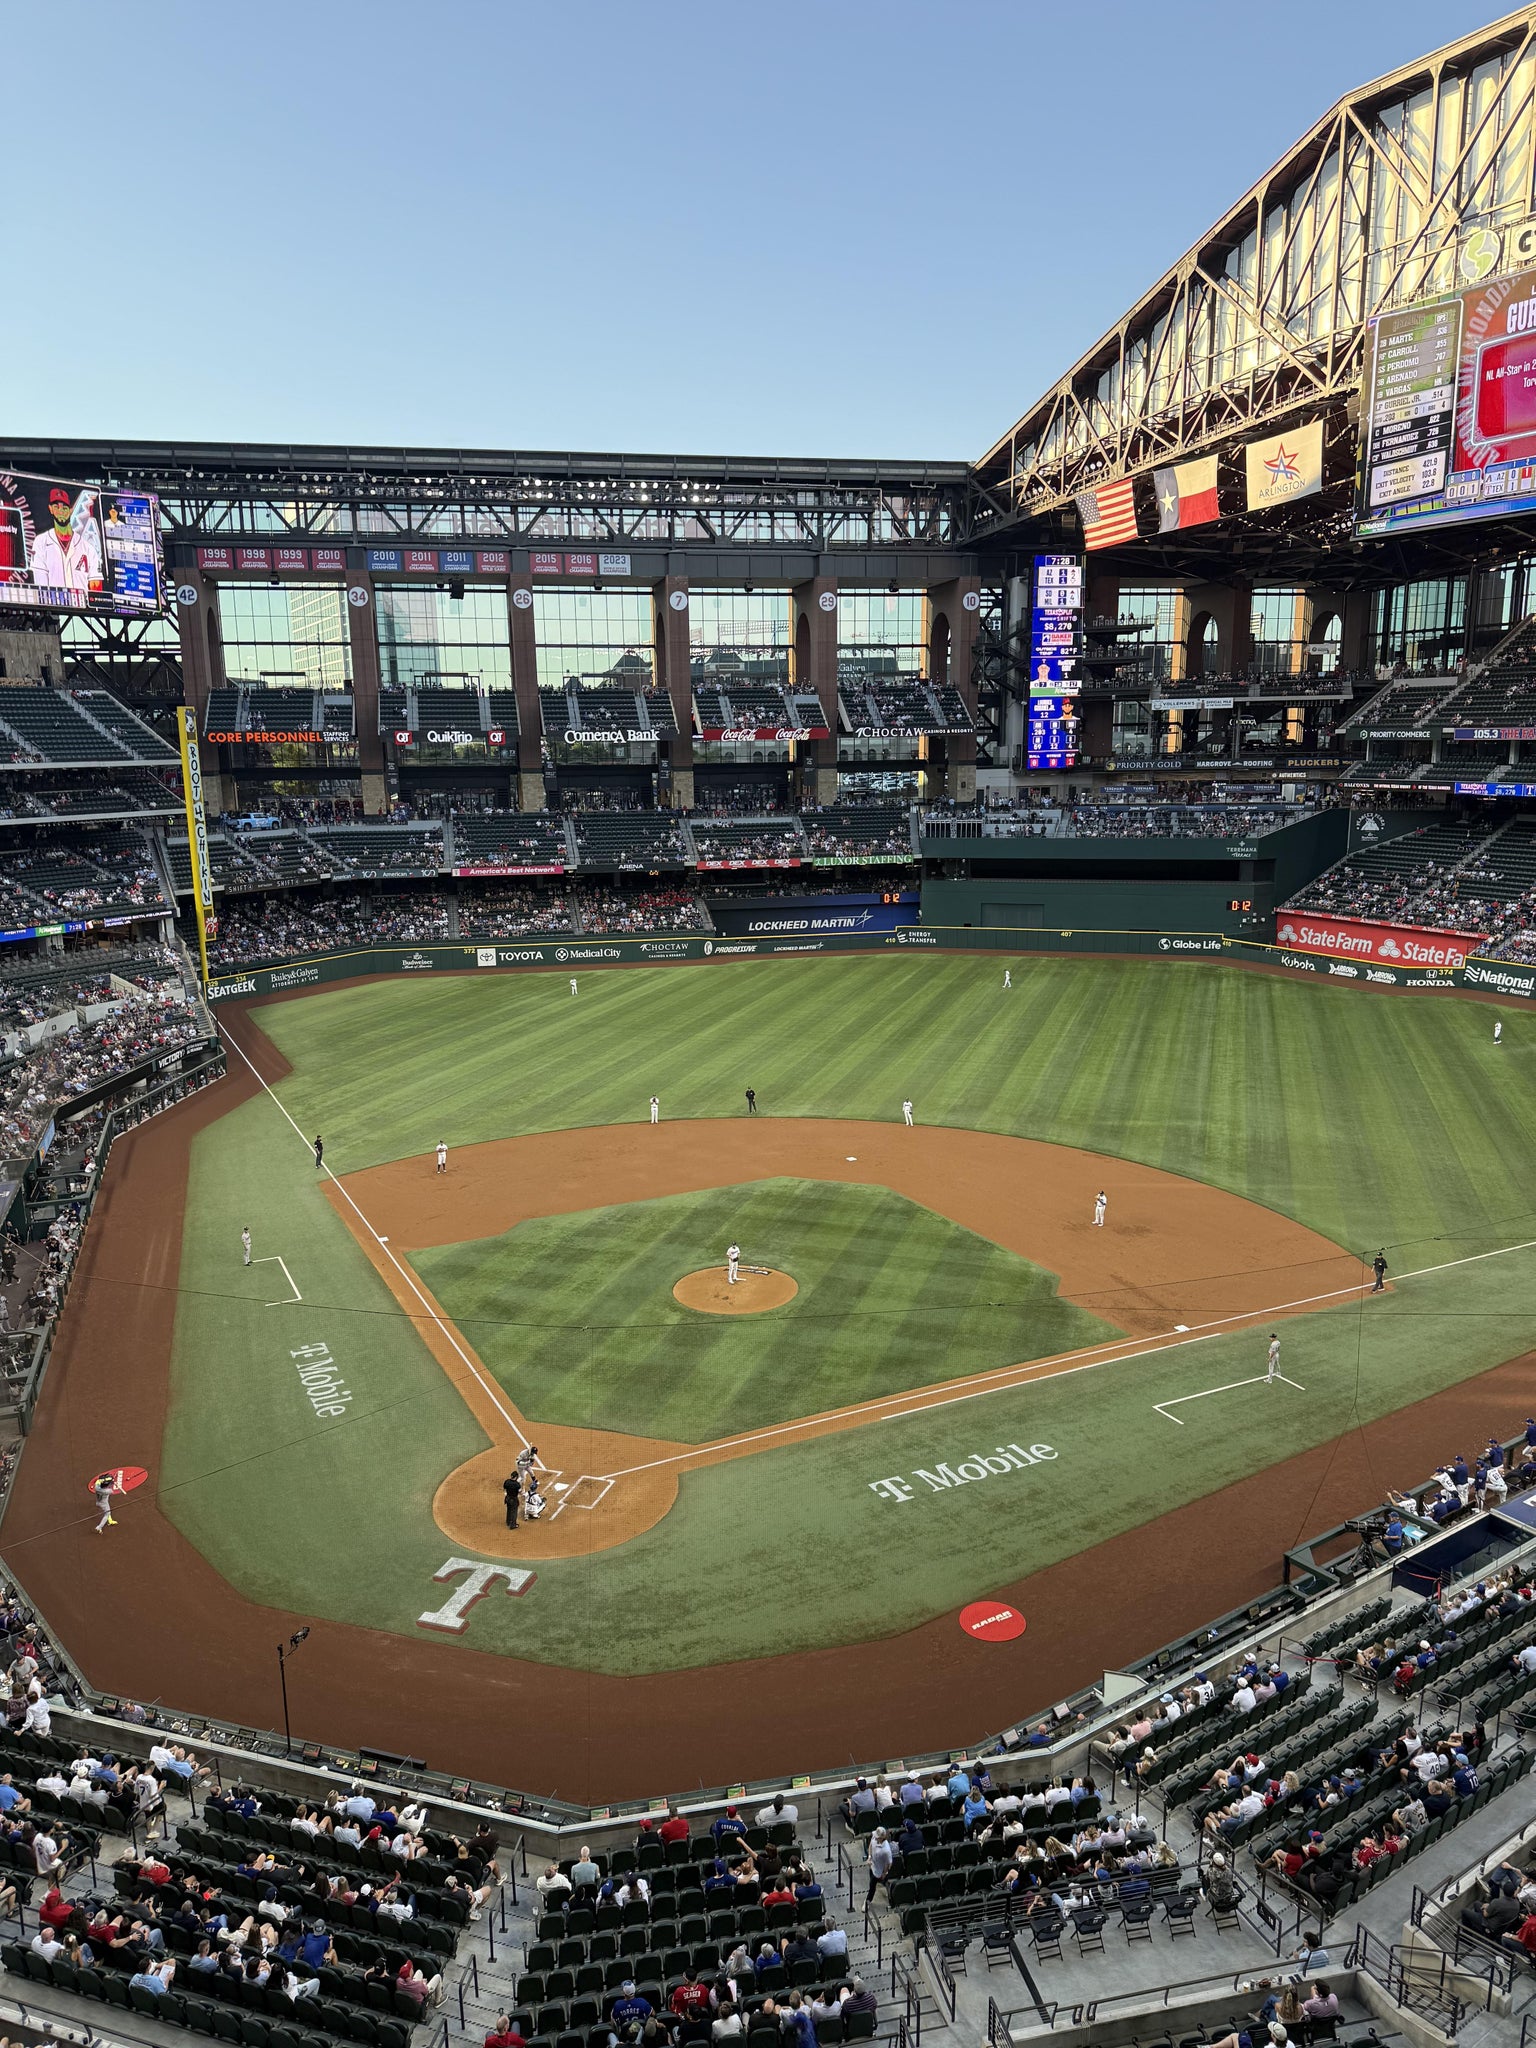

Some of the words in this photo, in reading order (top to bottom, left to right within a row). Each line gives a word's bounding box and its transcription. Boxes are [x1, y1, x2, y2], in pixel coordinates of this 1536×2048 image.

[1388, 333, 1413, 346] MARTE
[1387, 344, 1418, 358] CARROLL
[1386, 357, 1419, 371] PERDOMO
[1386, 370, 1417, 384] ARENADO
[1385, 384, 1411, 396] VARGAS
[1384, 397, 1410, 409] GURRIEL
[1383, 421, 1411, 435] MORENO
[1382, 432, 1419, 447] FERNANDEZ
[1383, 465, 1409, 477] DISTANCE
[1496, 472, 1504, 480] AZ
[1375, 480, 1388, 489] EXIT
[1389, 474, 1415, 486] VELOCITY
[1258, 479, 1306, 498] ARLINGTON
[1379, 490, 1392, 498] EXIT
[1392, 485, 1411, 495] ANGLE
[1492, 485, 1503, 493] TEX
[203, 549, 227, 559] 1996
[242, 549, 266, 559] 1998
[279, 550, 302, 559] 1999
[317, 550, 340, 560] 2010
[373, 551, 395, 561] 2010
[411, 552, 431, 562] 2011
[447, 552, 466, 562] 2011
[483, 553, 504, 562] 2012
[535, 554, 557, 564] 2015
[571, 555, 592, 564] 2016
[603, 555, 626, 565] 2023
[180, 589, 194, 601] 42
[351, 591, 366, 602] 34
[515, 593, 530, 605] 26
[676, 595, 682, 606] 7
[821, 596, 835, 607] 29
[966, 596, 976, 607] 10
[208, 732, 242, 743] CORE
[246, 731, 323, 743] PERSONNEL
[396, 732, 410, 743] QT
[427, 730, 473, 744] QuikTrip
[489, 732, 504, 743] QT
[627, 730, 660, 741] Bank
[721, 728, 756, 741] Coca-Cola
[775, 728, 811, 741] Coca-Cola
[863, 727, 924, 738] CHOCTAW
[1473, 729, 1498, 739] 105.3
[1501, 729, 1520, 738] THE
[1117, 761, 1153, 769] PRIORITY
[1288, 759, 1339, 767] PLUCKERS
[823, 856, 860, 866] LUXOR
[861, 854, 912, 864] STAFFING
[228, 884, 247, 893] SHIFT
[276, 879, 294, 887] SHIFT
[1231, 900, 1251, 911] 0:12
[749, 919, 809, 931] LOCKHEED
[811, 918, 855, 929] MARTIN
[645, 943, 689, 952] CHOCTAW
[714, 945, 758, 954] PROGRESSIVE
[1172, 940, 1202, 950] Globe
[1203, 940, 1221, 950] Life
[498, 951, 544, 961] TOYOTA
[570, 949, 604, 959] Medical
[604, 948, 621, 959] City
[1281, 955, 1316, 971] Kubota
[272, 979, 299, 988] ATTORNEYS
[1406, 979, 1456, 987] HONDA
[1479, 969, 1535, 990] National
[208, 978, 256, 1000] SEATGEEK
[1509, 987, 1531, 997] Rental
[158, 1050, 183, 1068] VICTORY
[296, 1356, 353, 1418] Mobile
[911, 1443, 1059, 1493] Mobile
[416, 1557, 538, 1635] T
[1429, 1763, 1440, 1776] 48
[1469, 1775, 1479, 1789] 10
[682, 1990, 701, 1999] SEAGER
[620, 2008, 640, 2016] TORRES
